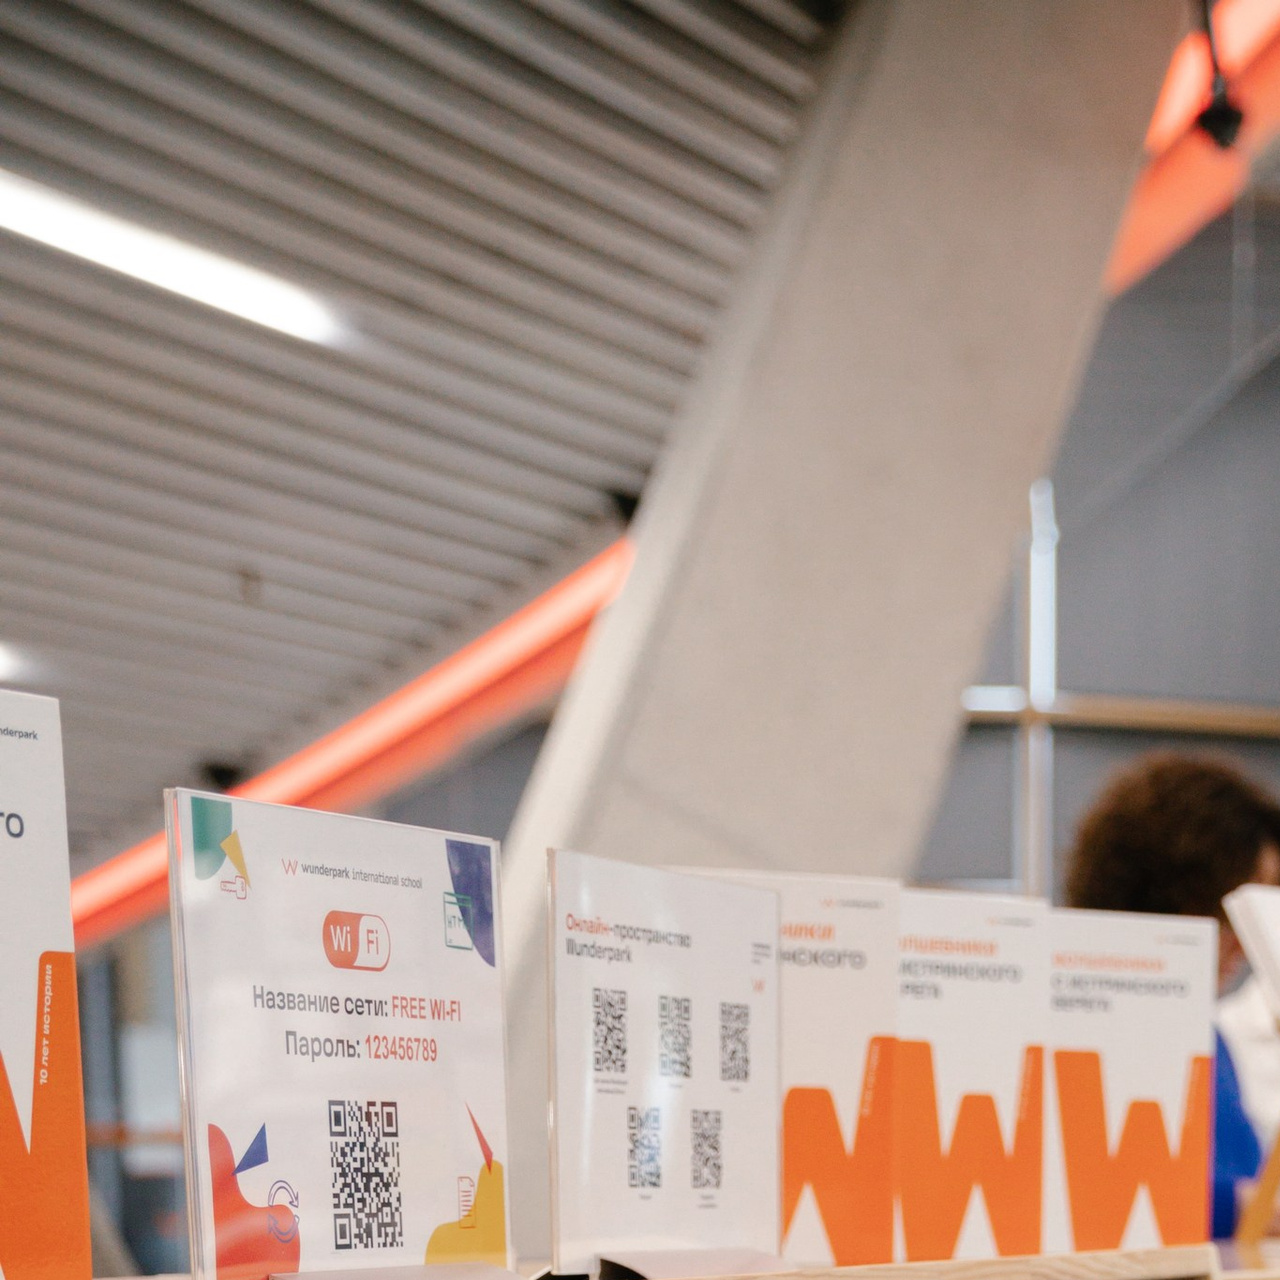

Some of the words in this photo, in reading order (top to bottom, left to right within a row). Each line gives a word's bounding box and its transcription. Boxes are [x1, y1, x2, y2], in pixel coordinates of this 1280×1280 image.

[301, 863, 350, 879] wunderpark
[352, 868, 400, 886] international
[400, 876, 423, 889] school
[330, 924, 351, 952] Wi
[366, 928, 380, 955] Fi
[43, 964, 53, 1035] истории
[253, 985, 340, 1014] Название
[344, 996, 389, 1018] сети:
[391, 995, 427, 1020] FREE
[430, 999, 462, 1022] WI-FI
[41, 1037, 50, 1067] лет
[285, 1030, 361, 1063] Пароль:
[364, 1034, 438, 1062] 123456789
[39, 1068, 49, 1086] 10
